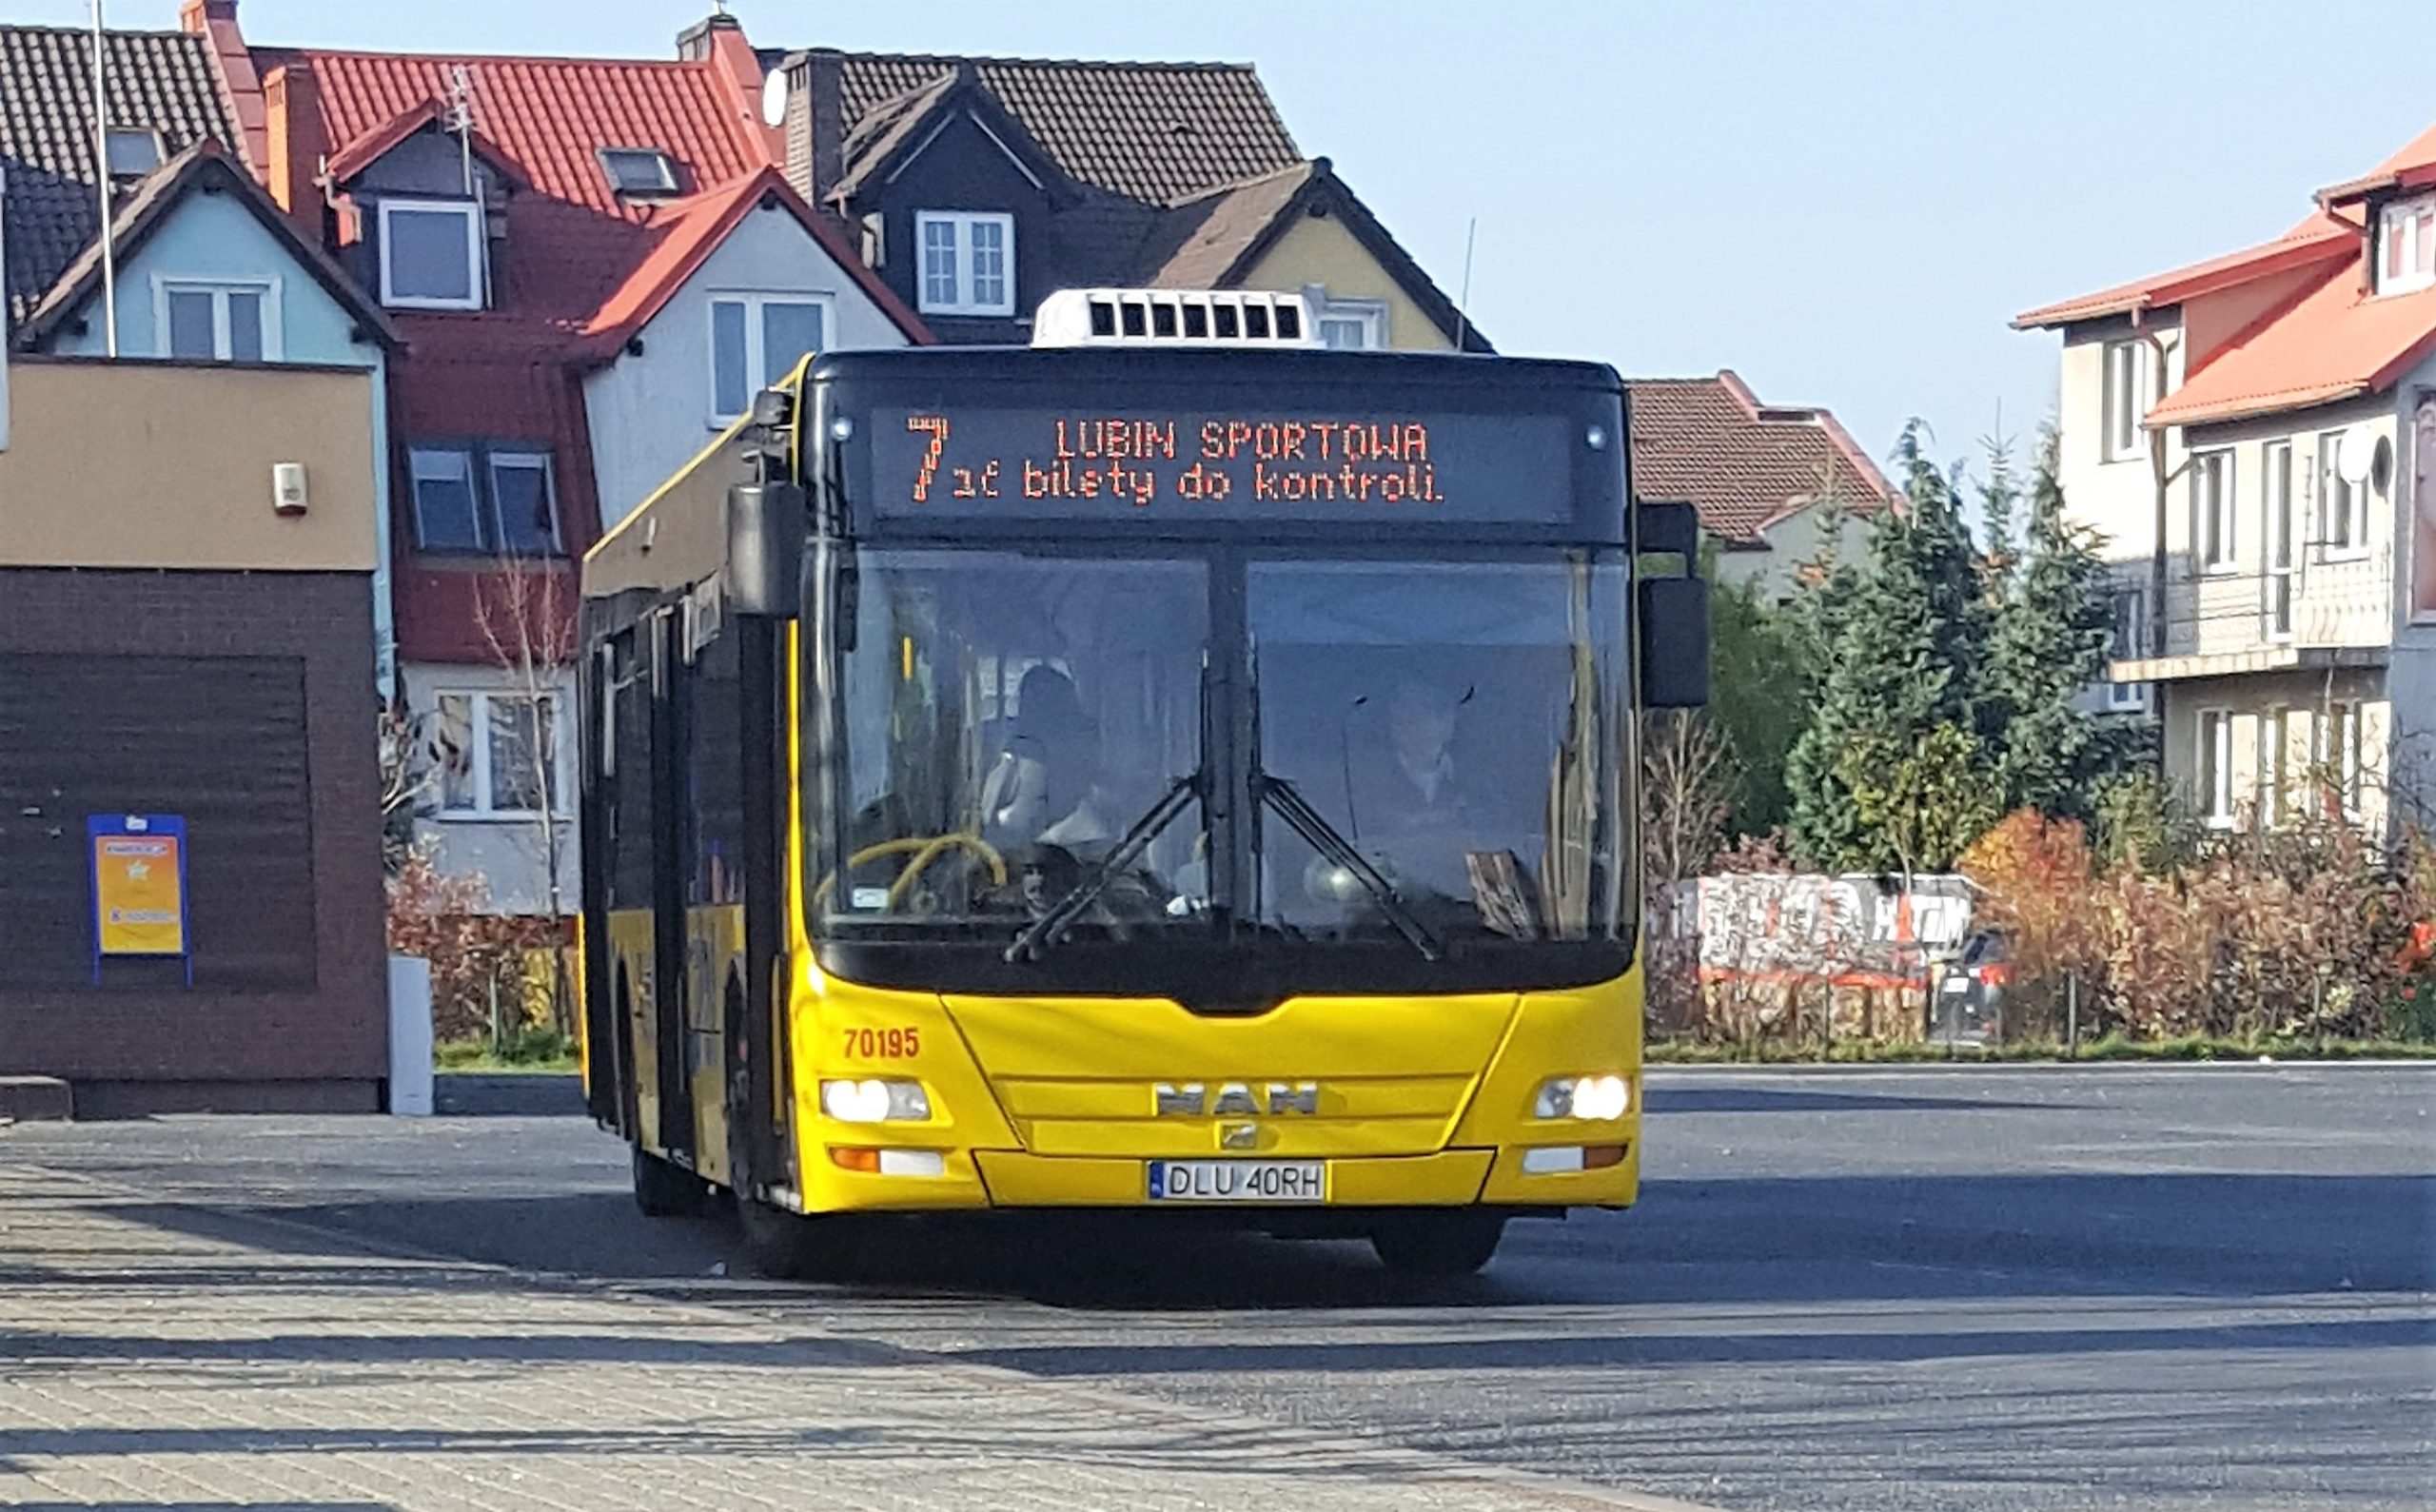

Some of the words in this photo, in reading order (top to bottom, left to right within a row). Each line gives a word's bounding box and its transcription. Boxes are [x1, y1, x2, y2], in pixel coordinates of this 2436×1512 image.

[1056, 420, 1174, 458] LUBIN
[1201, 421, 1426, 461] SPORTOWA
[908, 417, 949, 502] 7
[1024, 459, 1154, 506] bilety
[1178, 462, 1230, 501] do
[1255, 462, 1444, 501] kontroli.
[843, 1027, 920, 1058] 70195
[1152, 1082, 1317, 1115] MAN
[1169, 1167, 1233, 1195] DLU
[1246, 1167, 1319, 1196] 40RH
